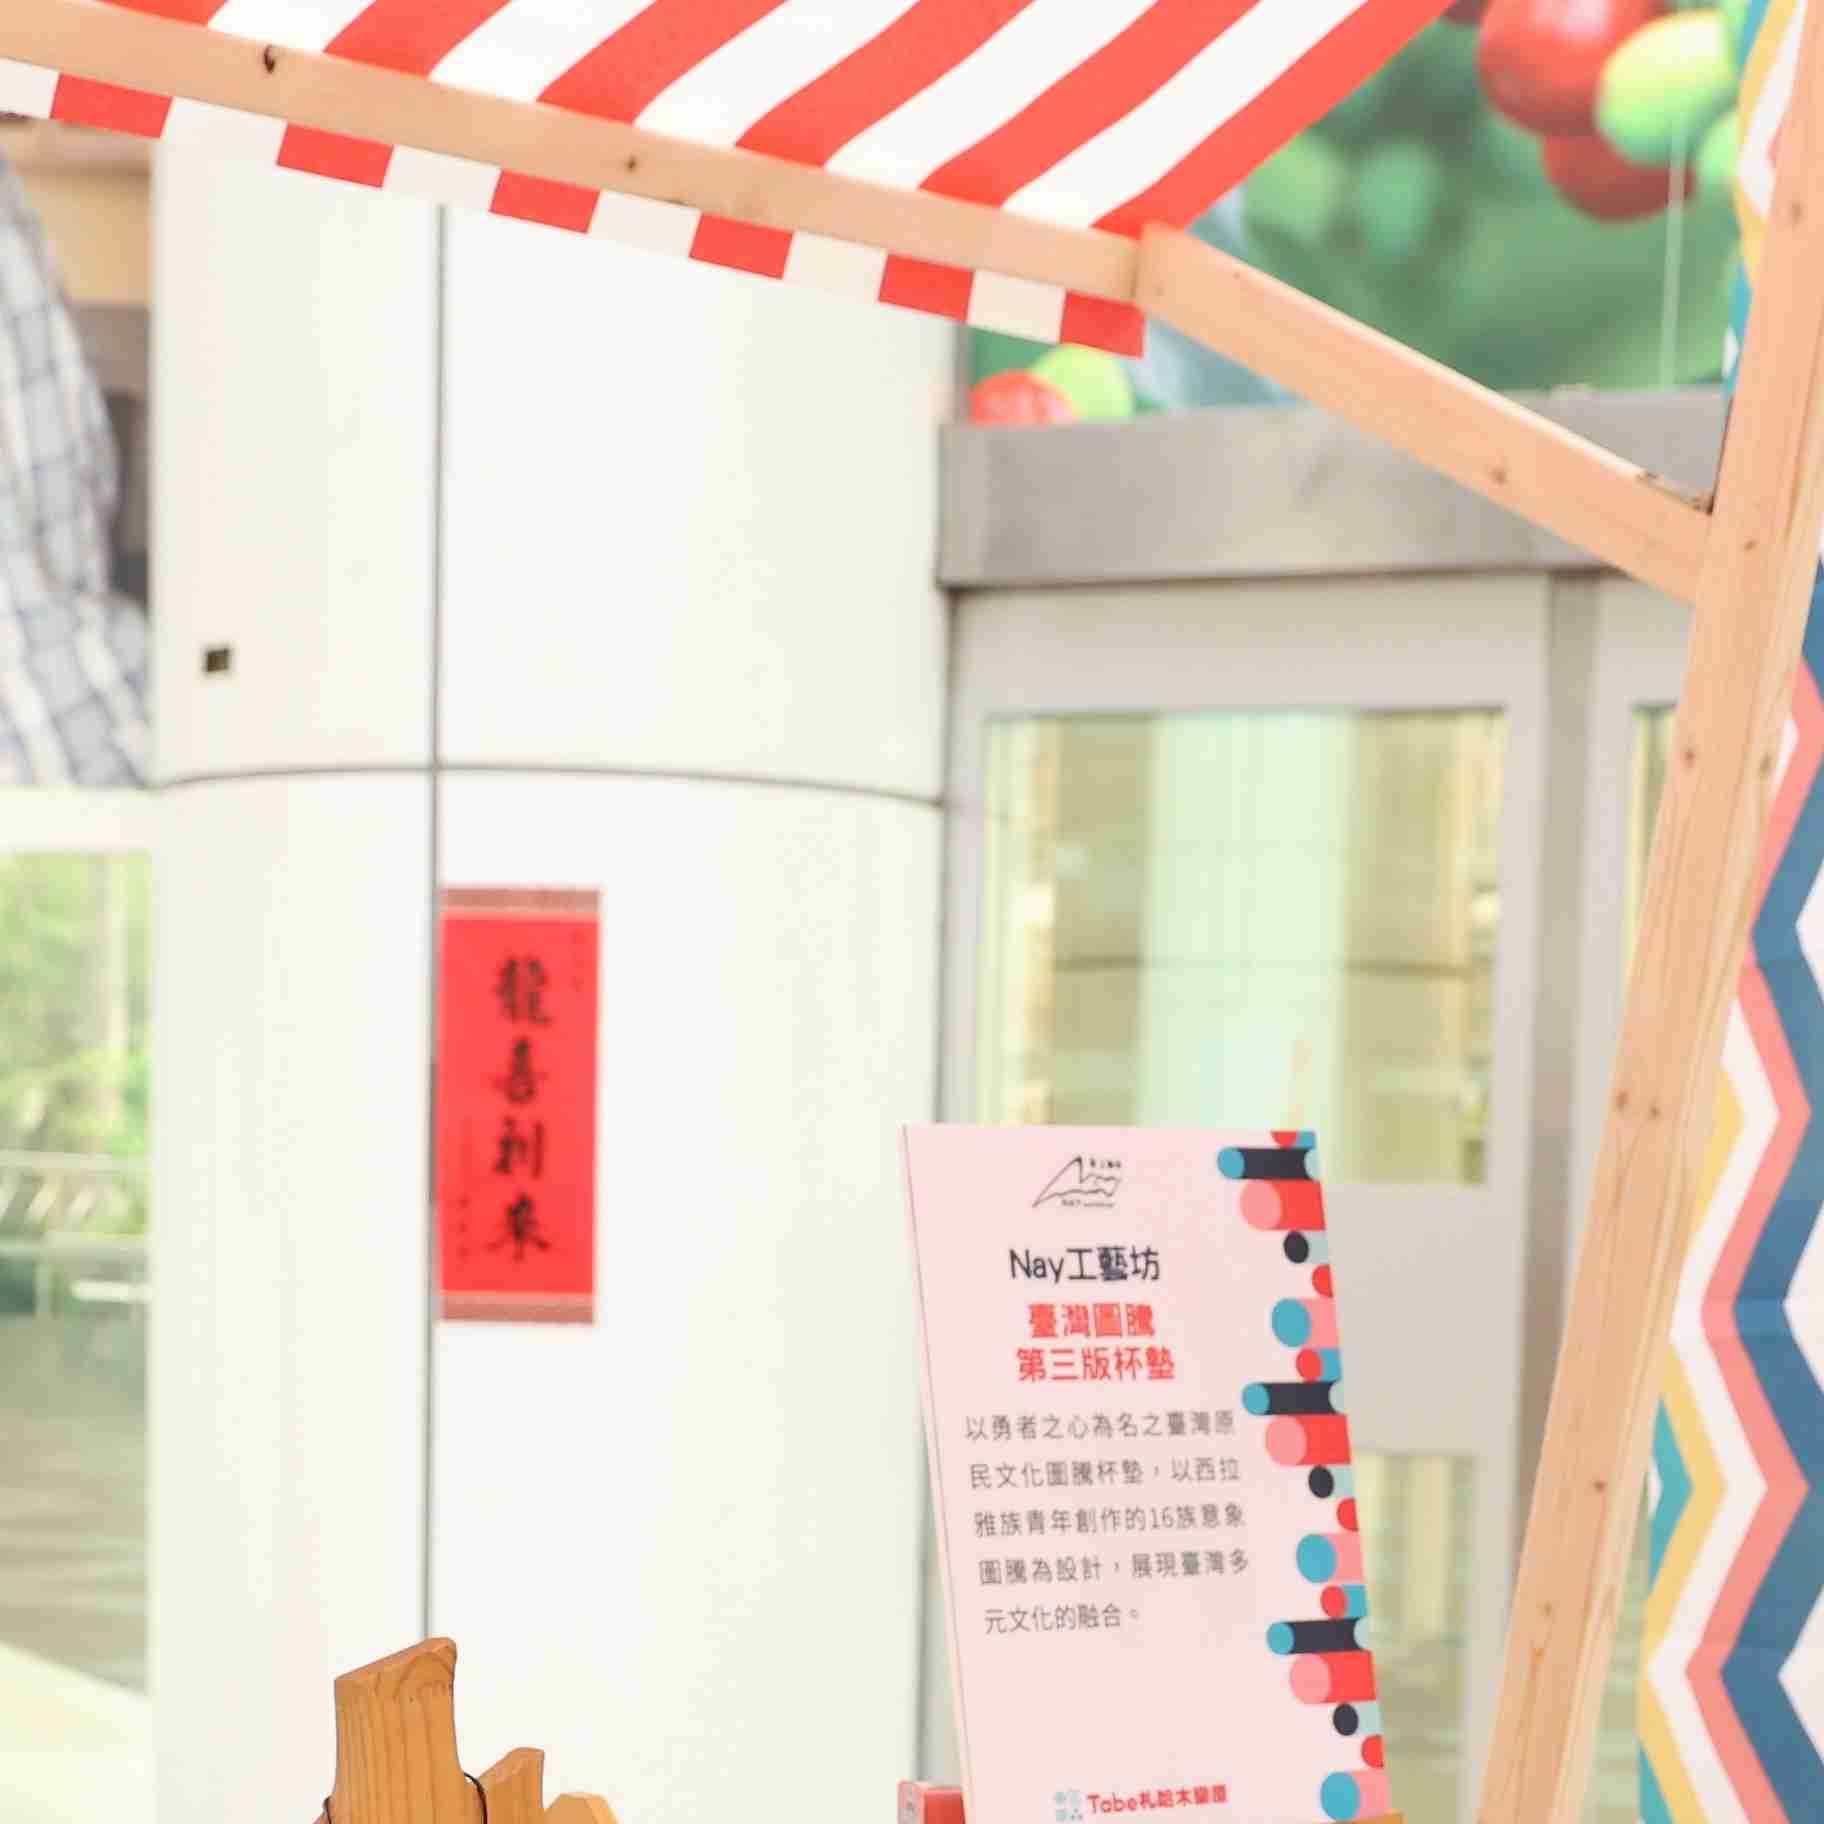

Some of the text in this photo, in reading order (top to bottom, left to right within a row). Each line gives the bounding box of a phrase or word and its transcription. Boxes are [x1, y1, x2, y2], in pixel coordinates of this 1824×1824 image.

[1009, 1246, 1162, 1283] Nay工藝坊
[1028, 1302, 1157, 1338] 臺灣圖騰
[1016, 1347, 1175, 1384] 第三版杯墊
